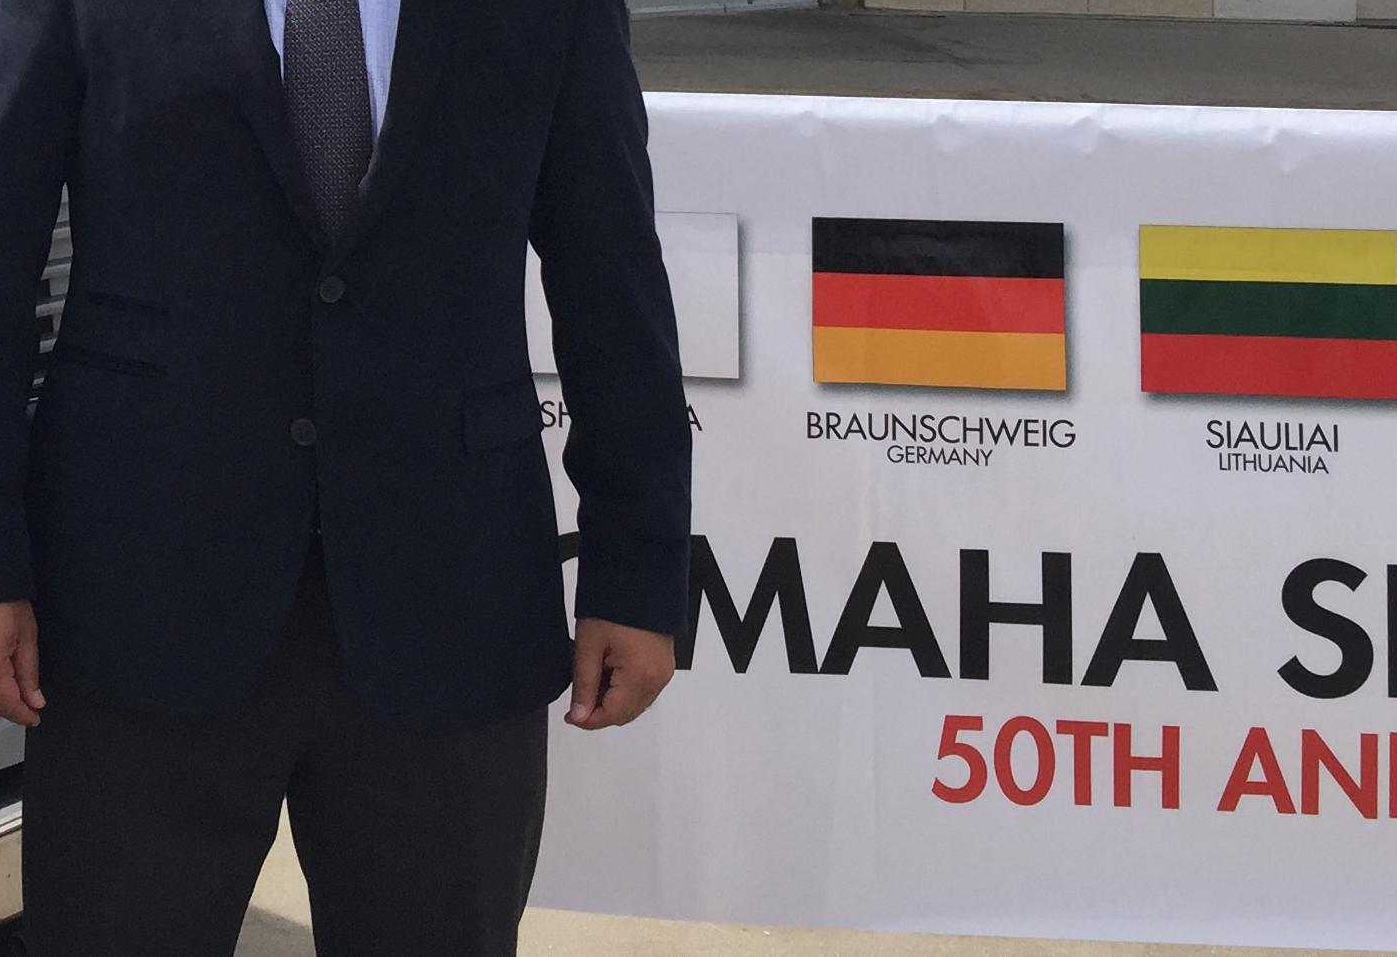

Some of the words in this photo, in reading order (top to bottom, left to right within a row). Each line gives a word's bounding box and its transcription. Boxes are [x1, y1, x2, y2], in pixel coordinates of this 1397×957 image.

[806, 411, 1077, 449] BRAUNSCHWEIG
[1205, 419, 1339, 452] SIAULIAI
[886, 444, 994, 466] GERMANY
[1218, 452, 1330, 475] LITHUANIA
[557, 531, 1218, 692] MAHA
[1276, 557, 1397, 699] S
[931, 714, 1180, 810] 50TH
